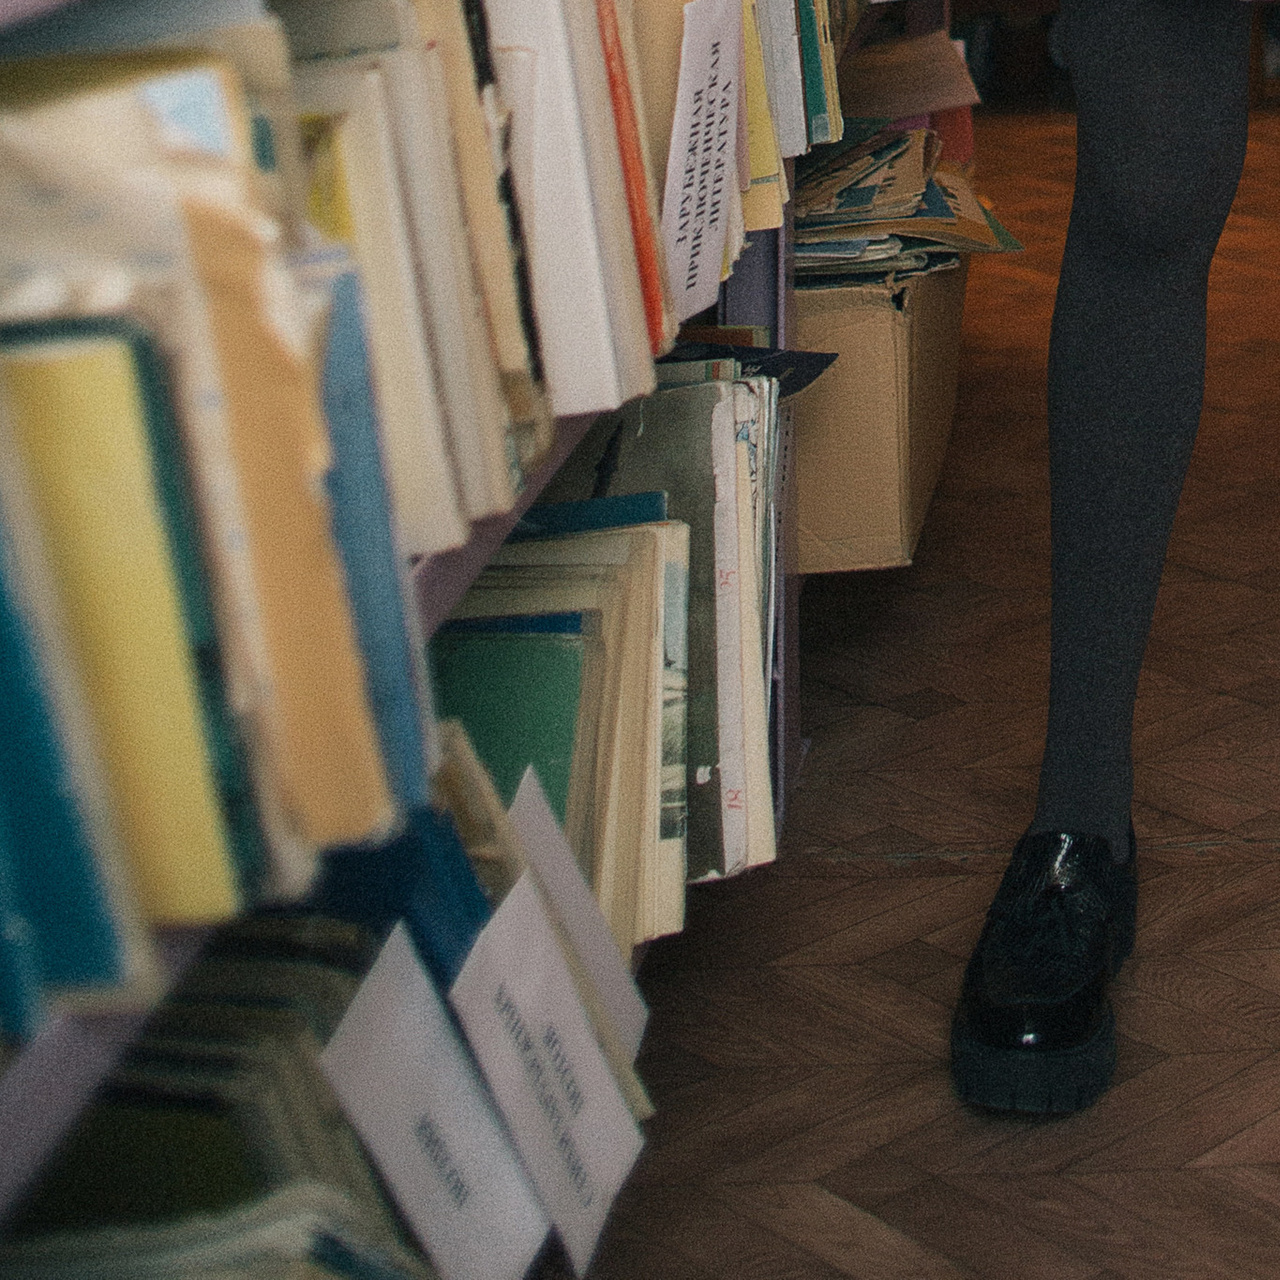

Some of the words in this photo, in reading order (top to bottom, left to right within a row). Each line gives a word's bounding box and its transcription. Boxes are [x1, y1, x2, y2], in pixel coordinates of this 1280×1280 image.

[675, 88, 704, 245] ЗАРУБЕЖНАЯ
[685, 40, 722, 291] ПРИКЛЮЧЕНЧЕСКАЯ
[708, 79, 733, 232] ЛИТЕРАТУРА
